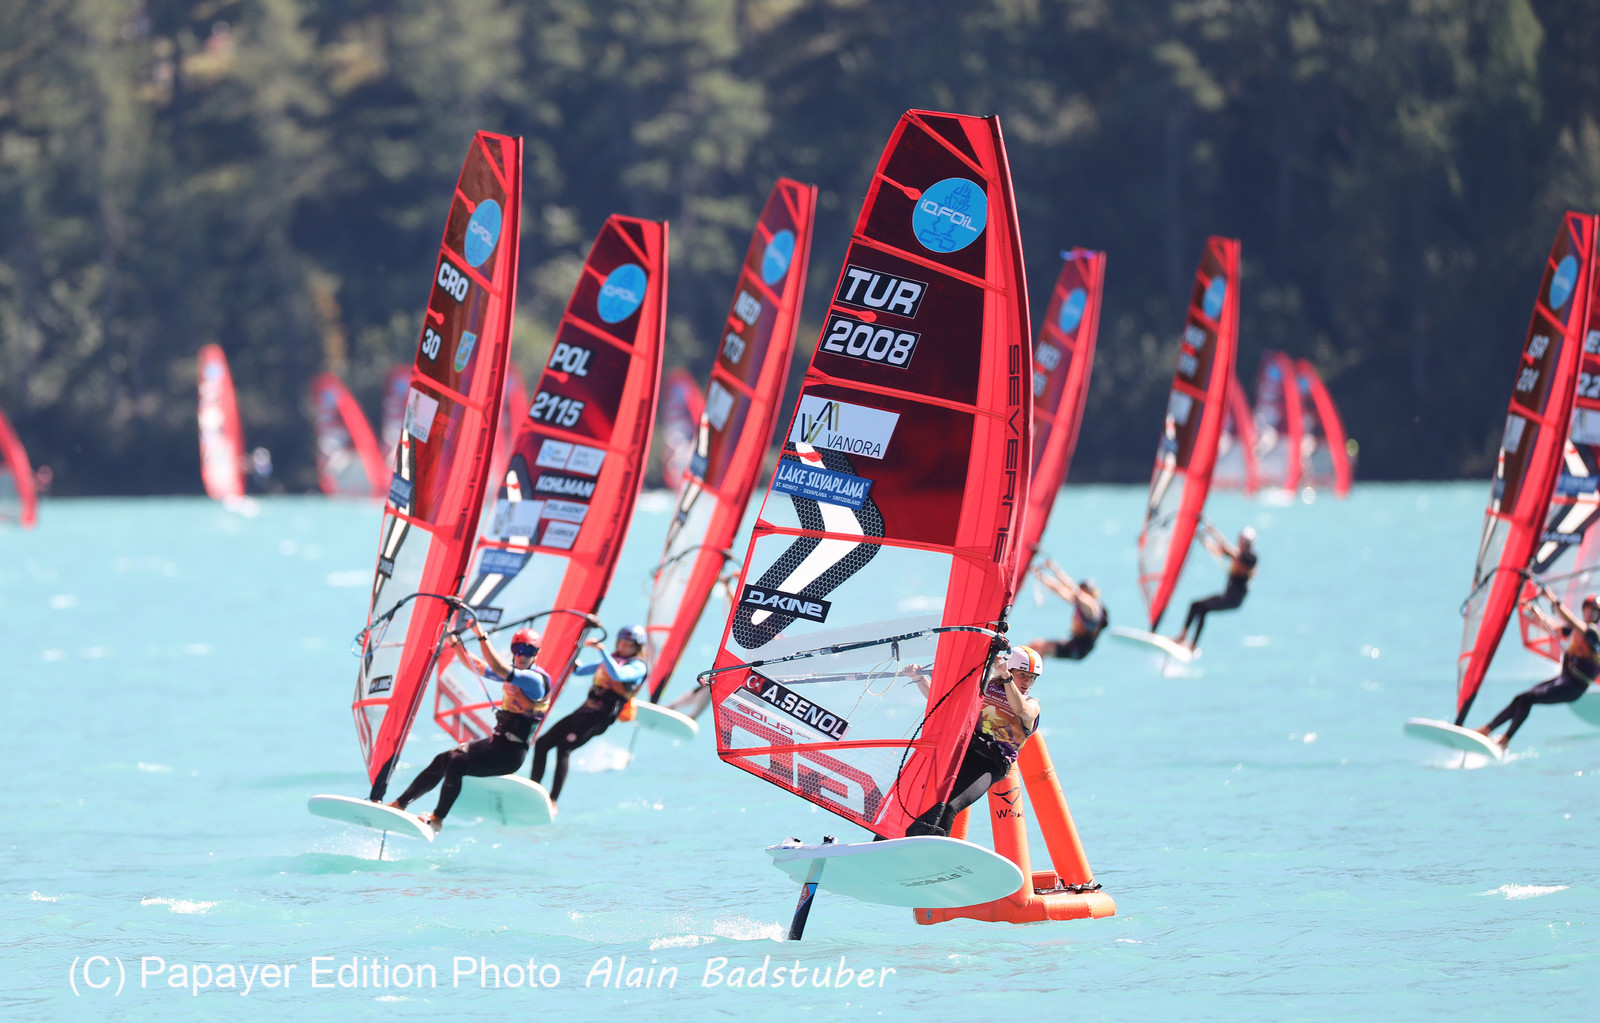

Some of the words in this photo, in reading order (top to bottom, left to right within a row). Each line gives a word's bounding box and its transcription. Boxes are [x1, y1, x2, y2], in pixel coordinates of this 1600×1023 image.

[437, 262, 469, 302] CRO
[844, 269, 922, 315] TUR
[422, 328, 441, 360] 30
[549, 342, 591, 377] POL
[823, 320, 916, 366] 2008
[528, 391, 585, 427] 2115
[827, 433, 881, 457] VANORA
[993, 344, 1020, 564] SEVERNE
[778, 464, 808, 485] LAKE
[805, 471, 866, 499] SILVAPLANA
